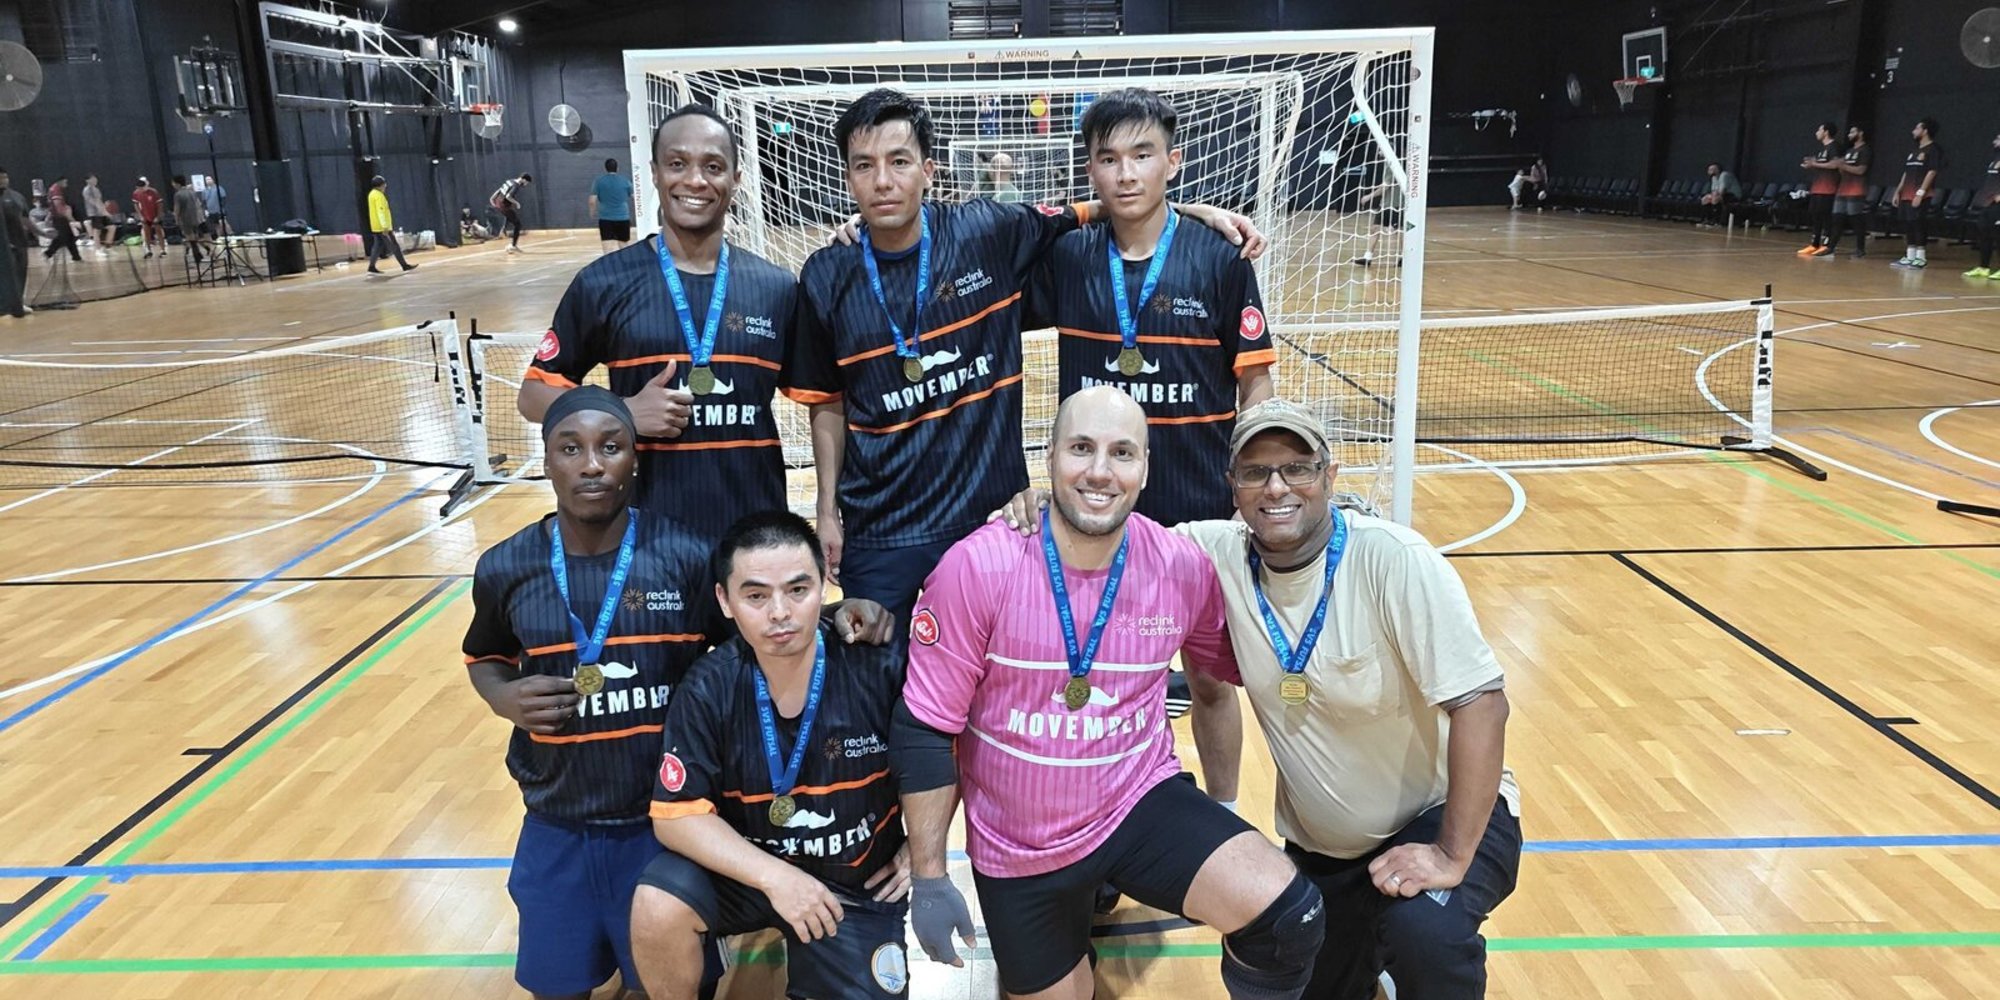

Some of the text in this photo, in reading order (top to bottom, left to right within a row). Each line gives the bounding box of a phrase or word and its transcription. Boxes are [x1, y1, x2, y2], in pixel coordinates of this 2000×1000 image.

[1005, 50, 1049, 58] WARNING
[1886, 70, 1894, 83] 3
[1411, 154, 1420, 198] WARNING
[634, 174, 643, 217] WARNING
[955, 268, 984, 287] reclink
[957, 276, 992, 297] australia
[745, 316, 773, 328] reclink
[611, 568, 624, 586] SVS
[1045, 540, 1064, 593] SVS FUTSAL
[646, 589, 682, 600] reclink
[1100, 575, 1118, 608] FUTSAL
[592, 594, 615, 645] SVS FUTSAL
[1060, 603, 1077, 655] SVS FUTSAL
[1138, 614, 1175, 626] reclink
[1138, 625, 1182, 636] australia
[1264, 612, 1291, 663] SVS FUTSAL
[1304, 627, 1316, 645] SVS
[1080, 636, 1098, 669] FUTSAL
[1293, 644, 1310, 671] FUTSA
[807, 657, 825, 709] SVS FUTSAL
[760, 705, 777, 756] SVS FUTSAL
[844, 733, 878, 748] reclink
[790, 718, 811, 768] SVS FUTSAL
[845, 743, 888, 758] australia
